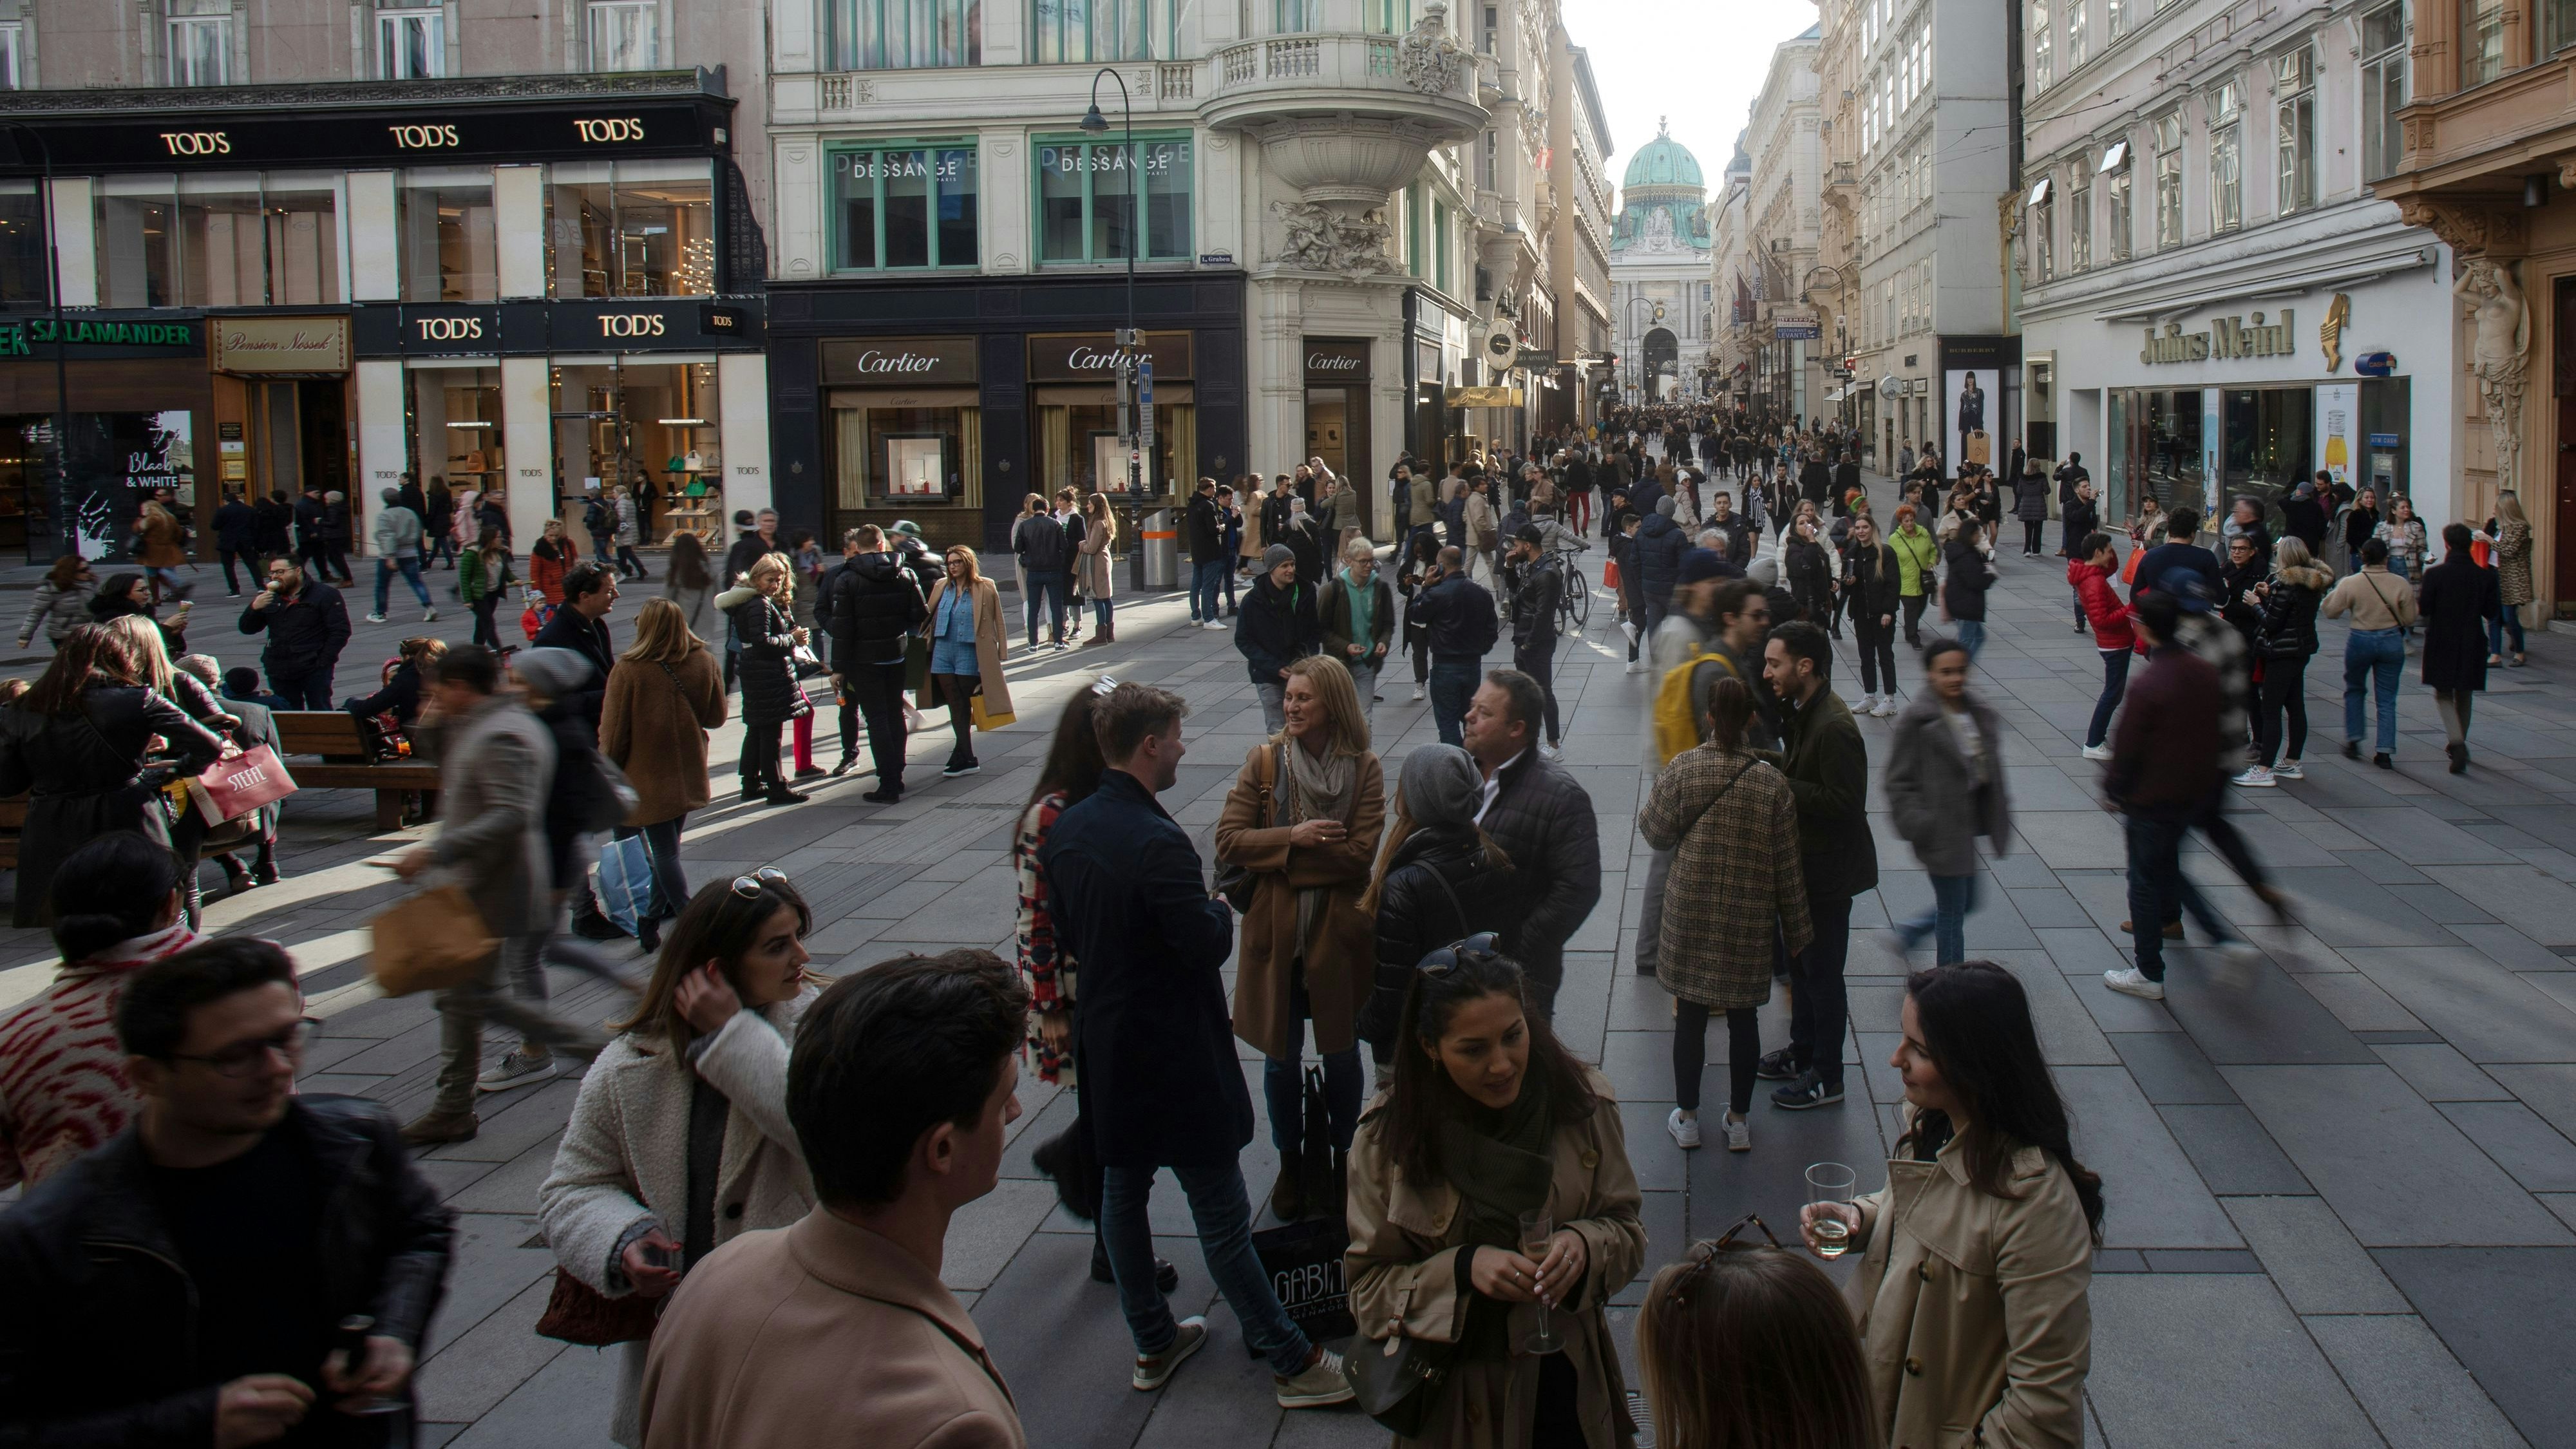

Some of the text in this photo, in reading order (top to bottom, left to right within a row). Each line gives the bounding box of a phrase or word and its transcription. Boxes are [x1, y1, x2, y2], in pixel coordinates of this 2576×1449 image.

[1754, 276, 1763, 300] Regus
[226, 330, 334, 352] Pension Nossek
[2140, 309, 2295, 365] Julius Meinl
[858, 350, 940, 373] Cartier
[1309, 352, 1360, 370] Cartier
[129, 451, 173, 473] Black
[126, 476, 178, 487] & WHITE
[227, 766, 267, 791] STEFFL
